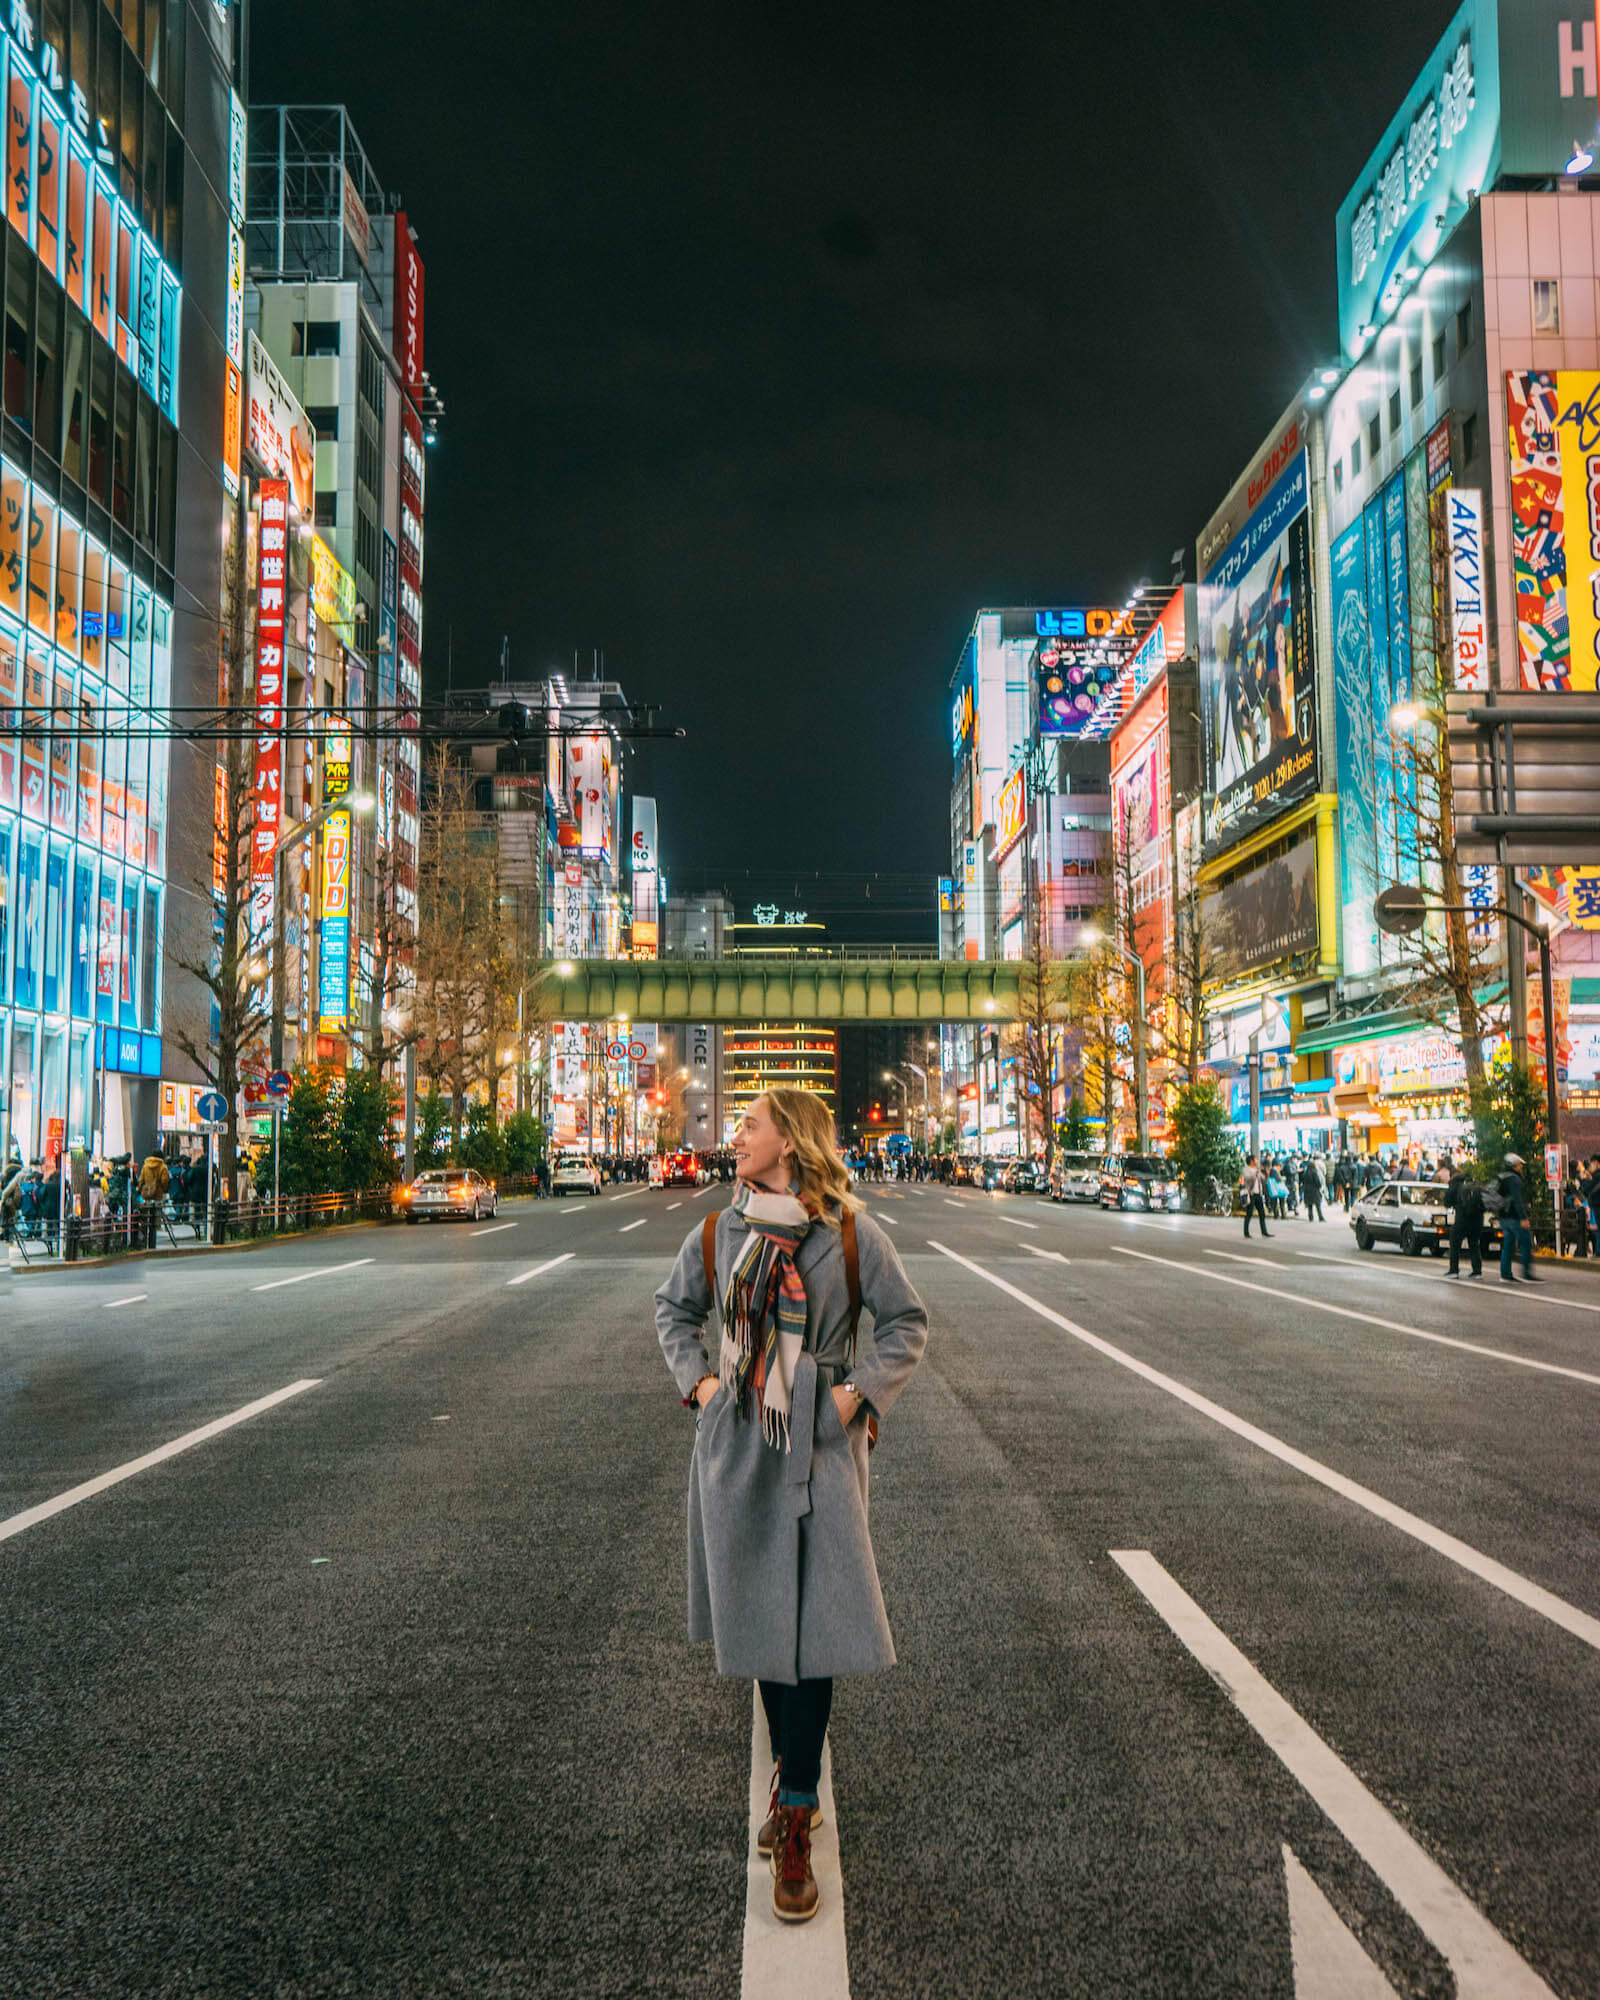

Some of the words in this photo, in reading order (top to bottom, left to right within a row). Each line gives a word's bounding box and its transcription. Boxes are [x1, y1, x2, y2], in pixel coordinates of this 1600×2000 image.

[1451, 496, 1481, 596] AKKY
[258, 644, 281, 754] カラオケ
[256, 768, 279, 853] パセラ
[325, 835, 347, 914] DVD
[632, 1046, 643, 1057] 50
